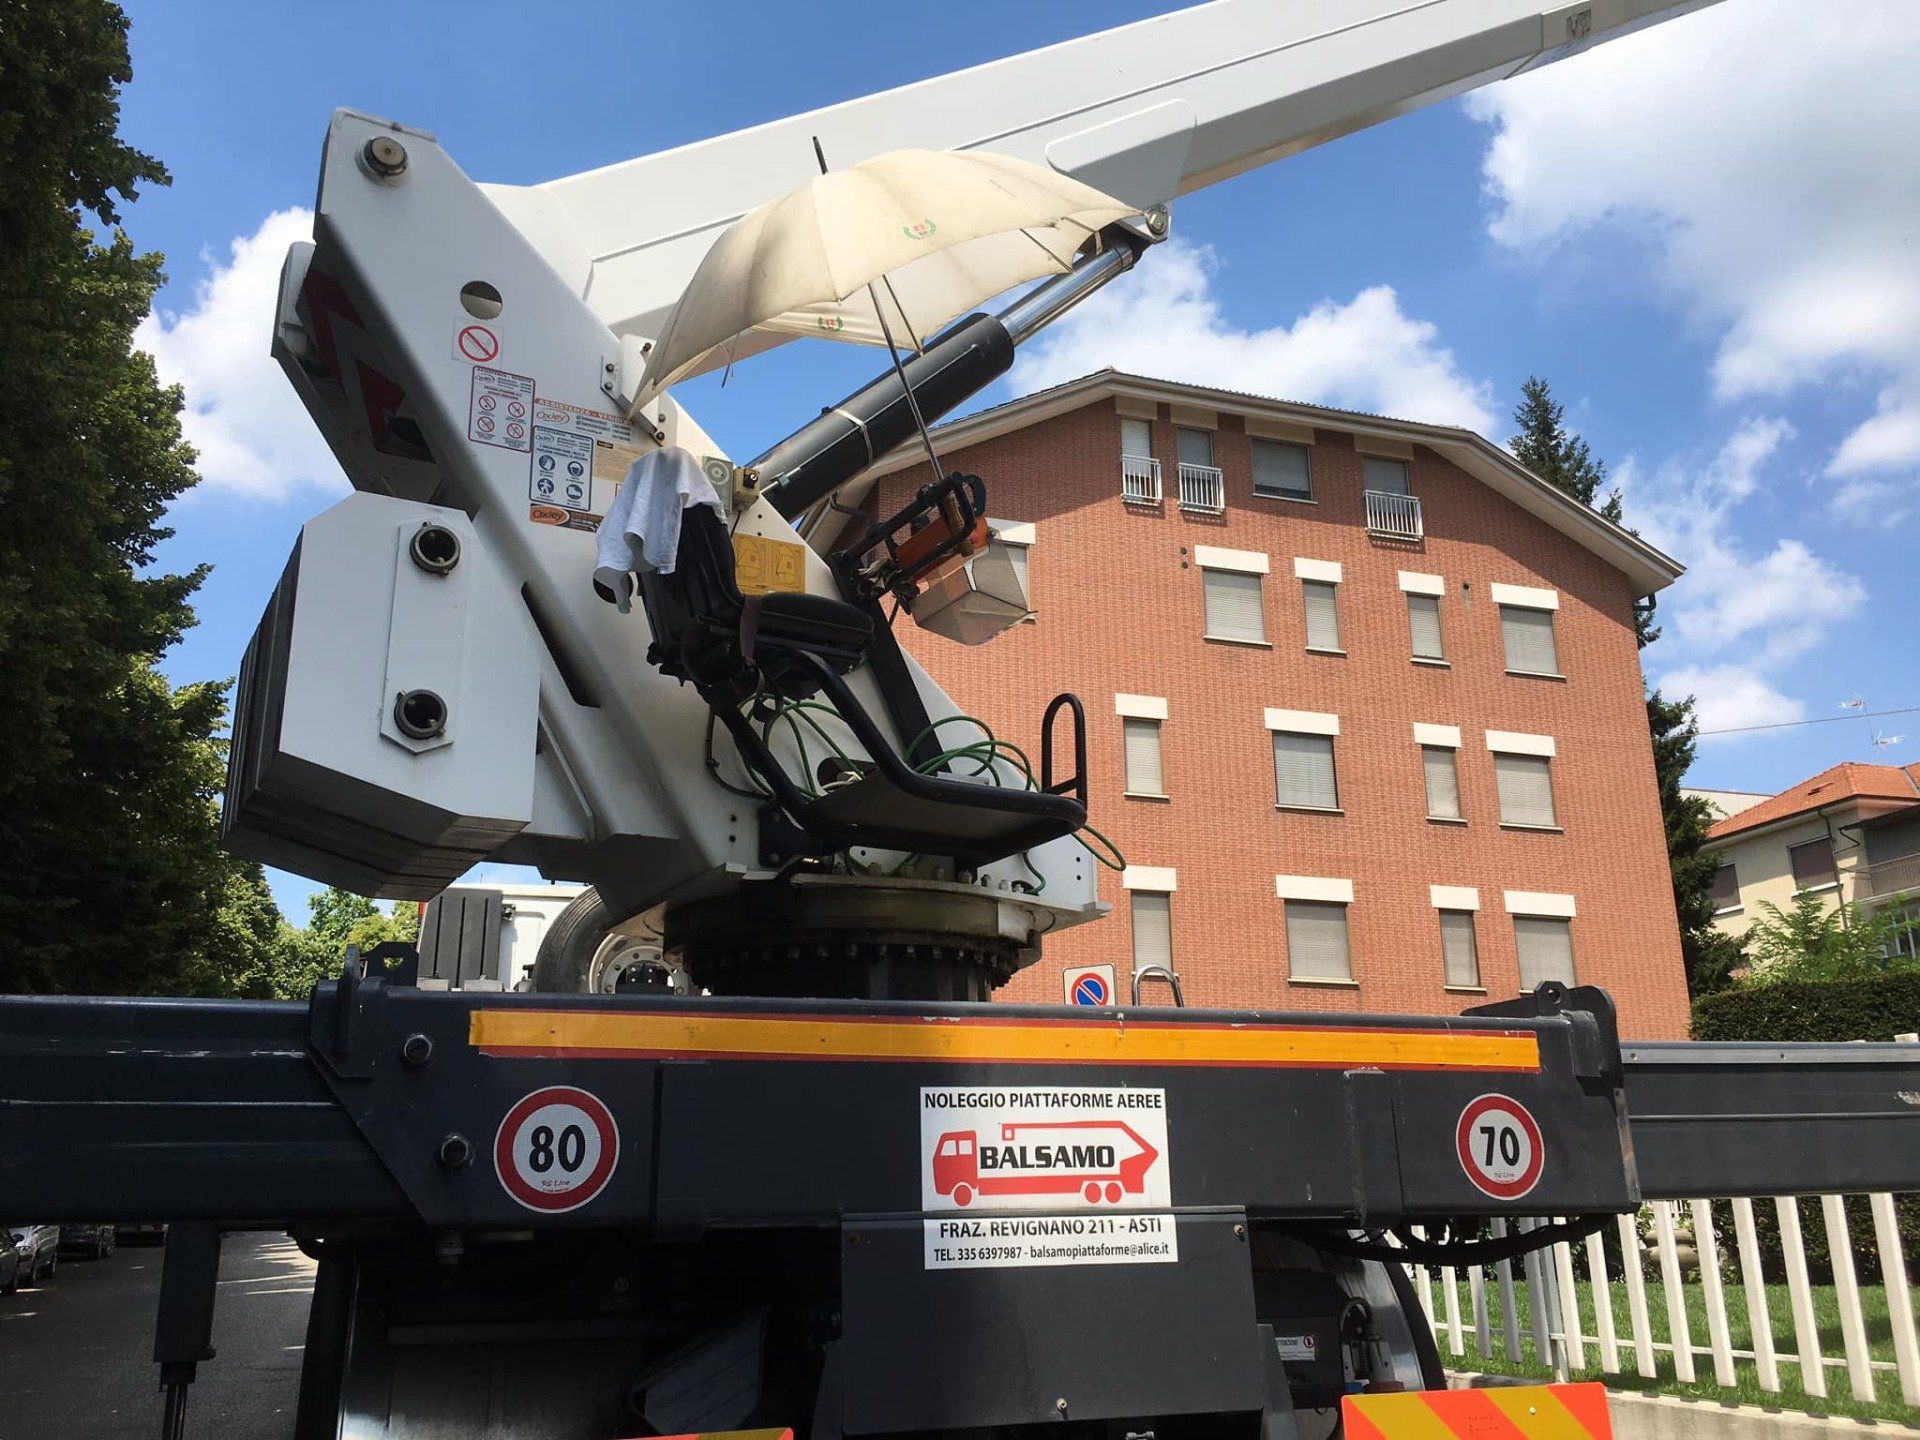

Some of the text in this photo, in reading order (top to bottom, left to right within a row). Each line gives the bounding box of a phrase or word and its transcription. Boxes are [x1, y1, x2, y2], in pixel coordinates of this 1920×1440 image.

[532, 509, 563, 522] Oxley
[925, 1092, 1162, 1109] NOLEGGIO PIATTAFORME AEREE
[529, 1124, 586, 1173] 80
[1479, 1125, 1520, 1167] 70
[979, 1145, 1115, 1170] BALSAMO
[940, 1221, 987, 1239] FRAZ.
[990, 1218, 1085, 1237] REVIGNANO
[1088, 1218, 1115, 1235] 211
[1128, 1217, 1162, 1234] ASTI
[934, 1248, 956, 1262] TEL.
[957, 1247, 977, 1260] 335
[978, 1246, 1022, 1260] 6397987
[1030, 1243, 1170, 1260] balsamopiattaforme@alice.it
